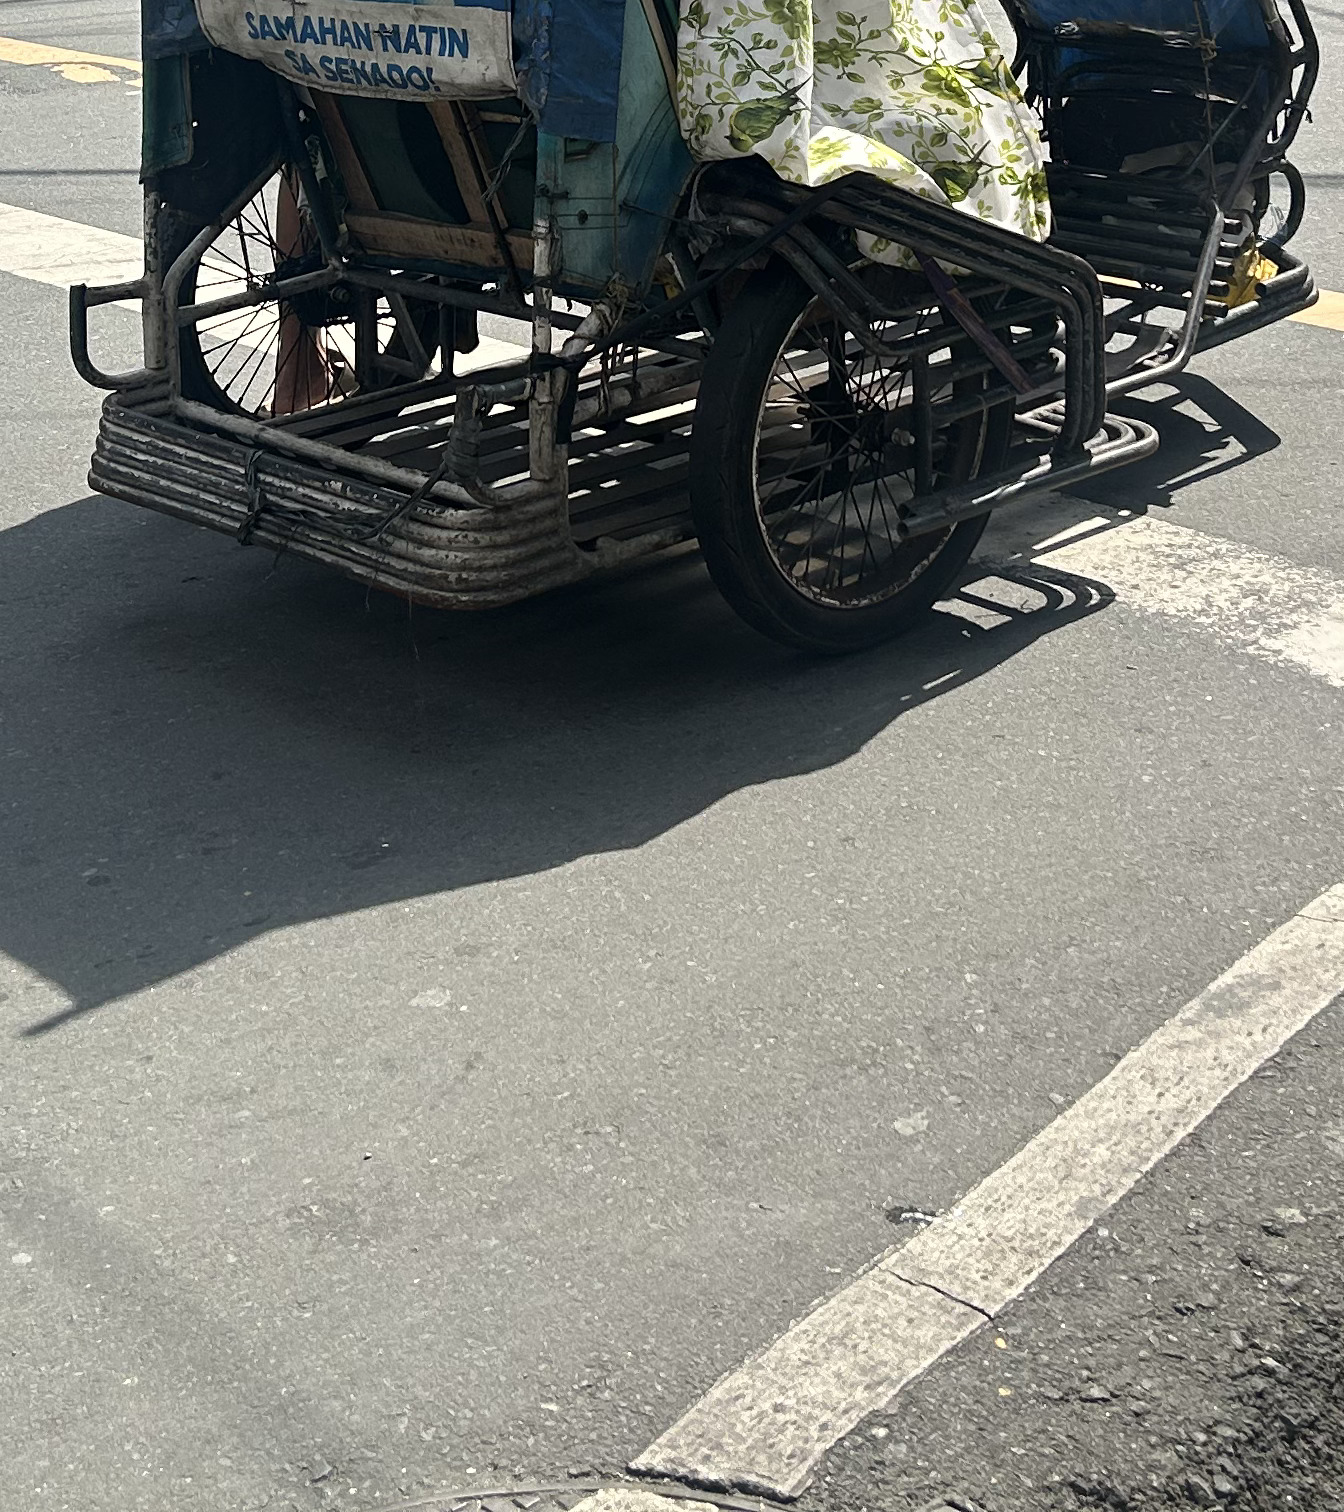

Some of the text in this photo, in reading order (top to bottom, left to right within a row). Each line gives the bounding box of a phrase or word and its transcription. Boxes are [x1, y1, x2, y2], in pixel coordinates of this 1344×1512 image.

[245, 11, 469, 58] SAMAHAN NATIN
[284, 49, 441, 92] SA SENADO!
